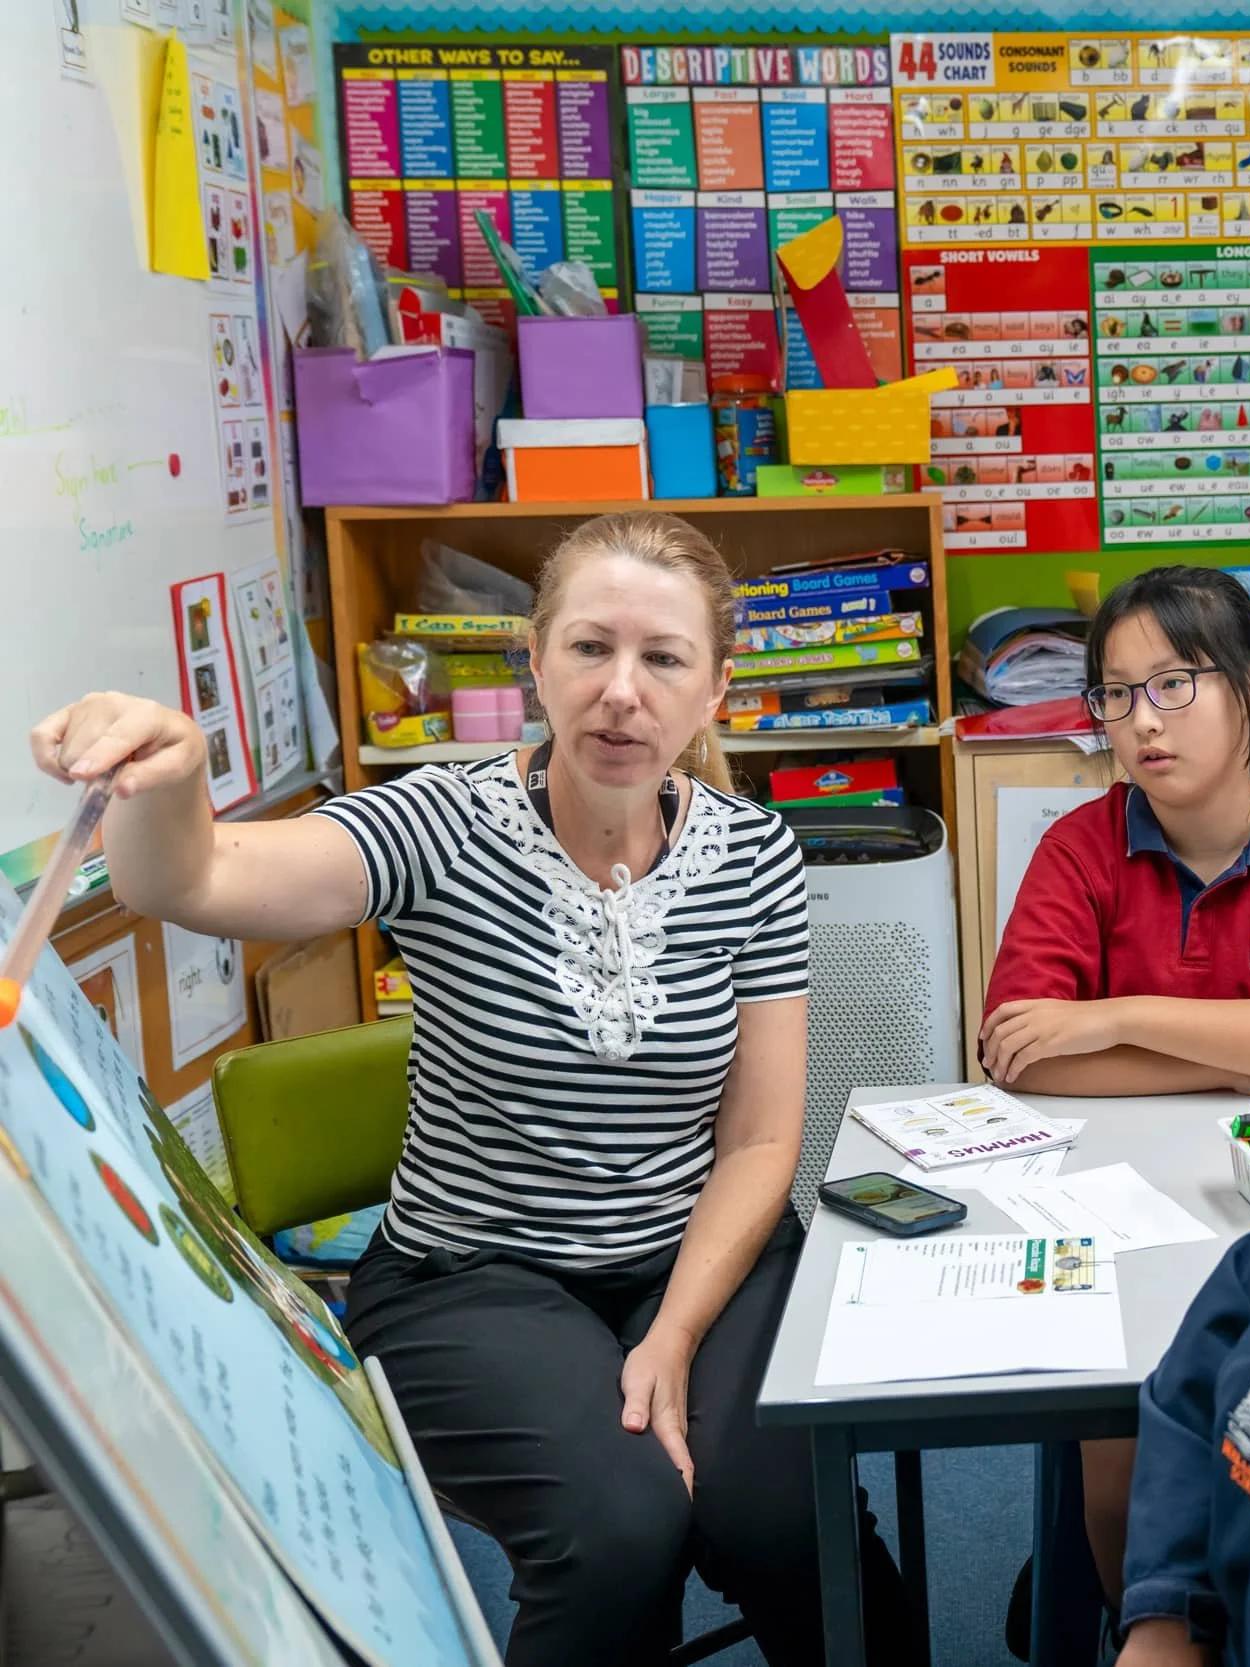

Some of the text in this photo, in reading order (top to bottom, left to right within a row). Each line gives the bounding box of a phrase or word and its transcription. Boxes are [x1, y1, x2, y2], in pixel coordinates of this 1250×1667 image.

[939, 43, 990, 60] SOUNDS
[1000, 46, 1064, 58] CONSONANT
[368, 49, 579, 65] OTHER WAYS TO SAY...
[899, 42, 937, 80] 44
[624, 49, 887, 82] DESCRIPTIVE WORDS
[1008, 62, 1057, 72] SOUNDS
[944, 66, 987, 81] CHART
[643, 90, 676, 99] Large
[715, 90, 736, 98] Fast
[782, 91, 805, 99] Said
[845, 92, 873, 100] Hard
[939, 125, 956, 135] wh
[1064, 123, 1087, 138] dge
[972, 175, 987, 186] kn
[644, 193, 681, 203] Happy
[717, 195, 742, 204] Kind
[786, 196, 816, 205] Small
[849, 196, 877, 205] Walk
[940, 250, 1039, 263] SHORT VOWELS
[651, 298, 685, 308] Funny
[727, 297, 752, 307] Easy
[854, 296, 875, 305] Sad
[792, 576, 830, 591] Board
[833, 573, 877, 587] Games
[748, 608, 786, 621] Board
[789, 605, 832, 618] Games
[401, 619, 513, 632] I Can Spell
[1042, 808, 1059, 817] She
[179, 967, 203, 998] right
[948, 1131, 1052, 1159] HUMMUS
